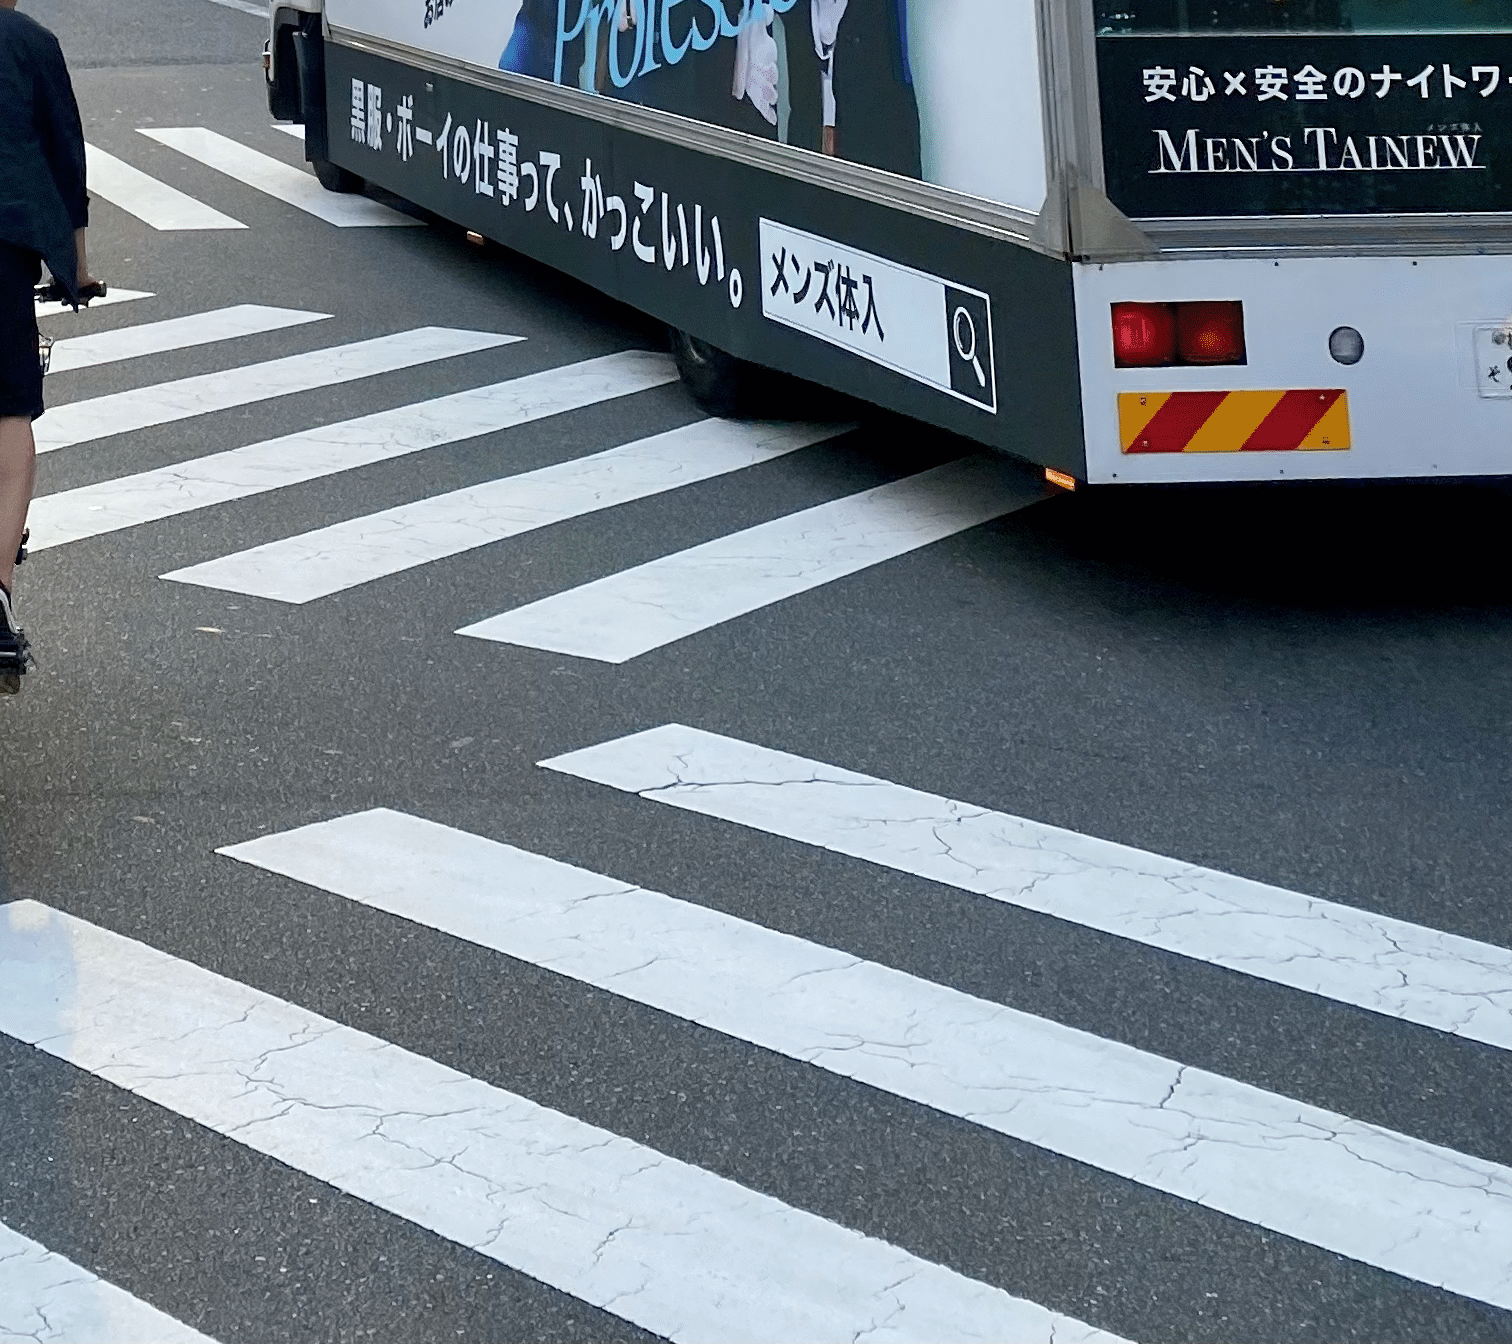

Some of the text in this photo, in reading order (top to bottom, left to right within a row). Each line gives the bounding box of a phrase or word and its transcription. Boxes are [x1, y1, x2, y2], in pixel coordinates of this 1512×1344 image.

[1142, 64, 1512, 103] 安心×安全のナイトワ
[350, 78, 744, 309] 黒服・ボーイの仕事って、かっこいい。
[770, 246, 885, 343] メンズ体入
